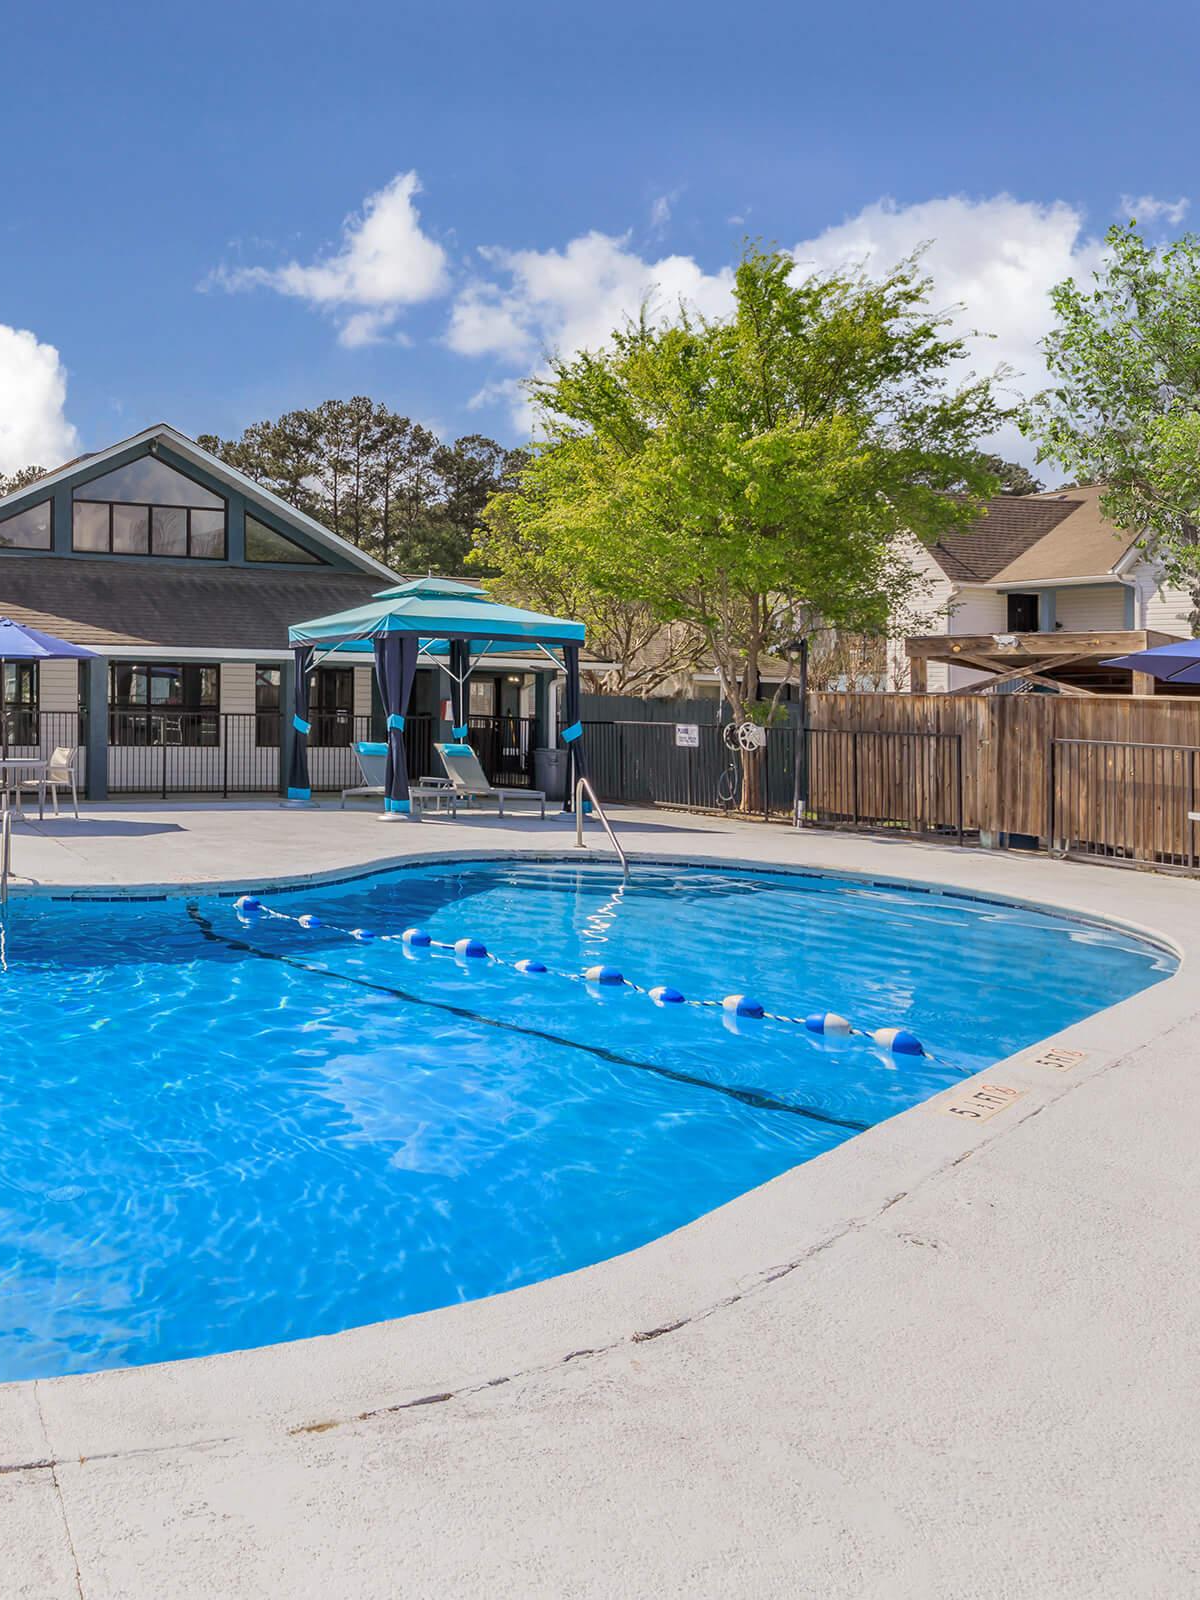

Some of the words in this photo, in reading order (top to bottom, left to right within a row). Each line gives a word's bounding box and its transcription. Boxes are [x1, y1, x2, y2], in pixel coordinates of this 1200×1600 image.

[1035, 1060, 1064, 1068] 5
[1044, 1053, 1075, 1064] FT
[949, 1107, 981, 1117] 5
[972, 1092, 1008, 1104] FT
